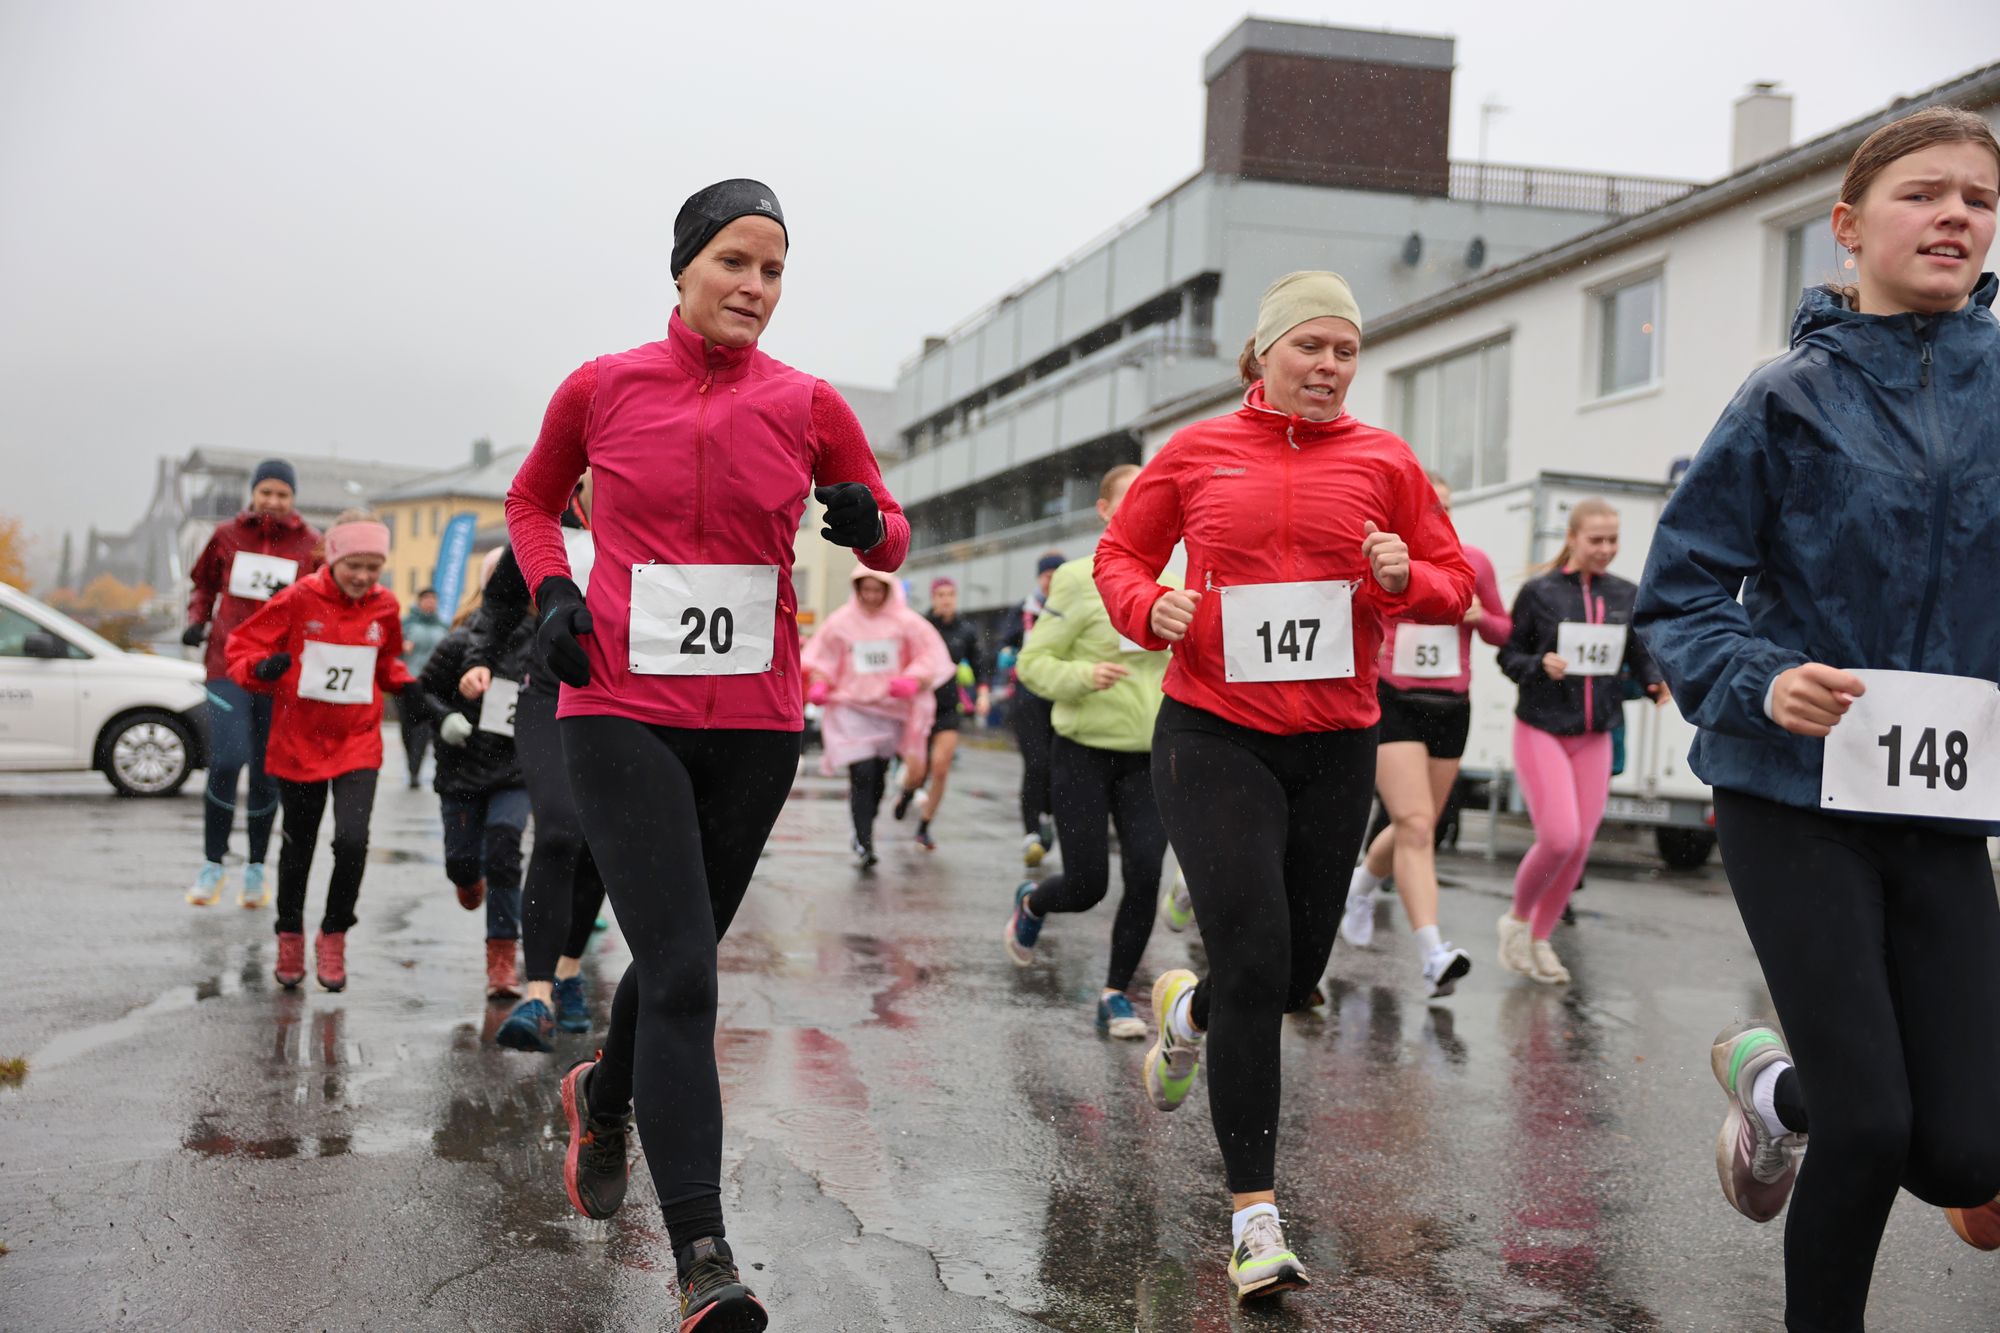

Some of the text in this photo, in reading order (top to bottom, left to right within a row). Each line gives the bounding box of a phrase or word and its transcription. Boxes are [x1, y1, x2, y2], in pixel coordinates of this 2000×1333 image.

[680, 607, 734, 655] 20
[1257, 618, 1321, 664] 147
[325, 667, 353, 691] 27
[1415, 645, 1441, 667] 53
[1878, 724, 1969, 791] 148
